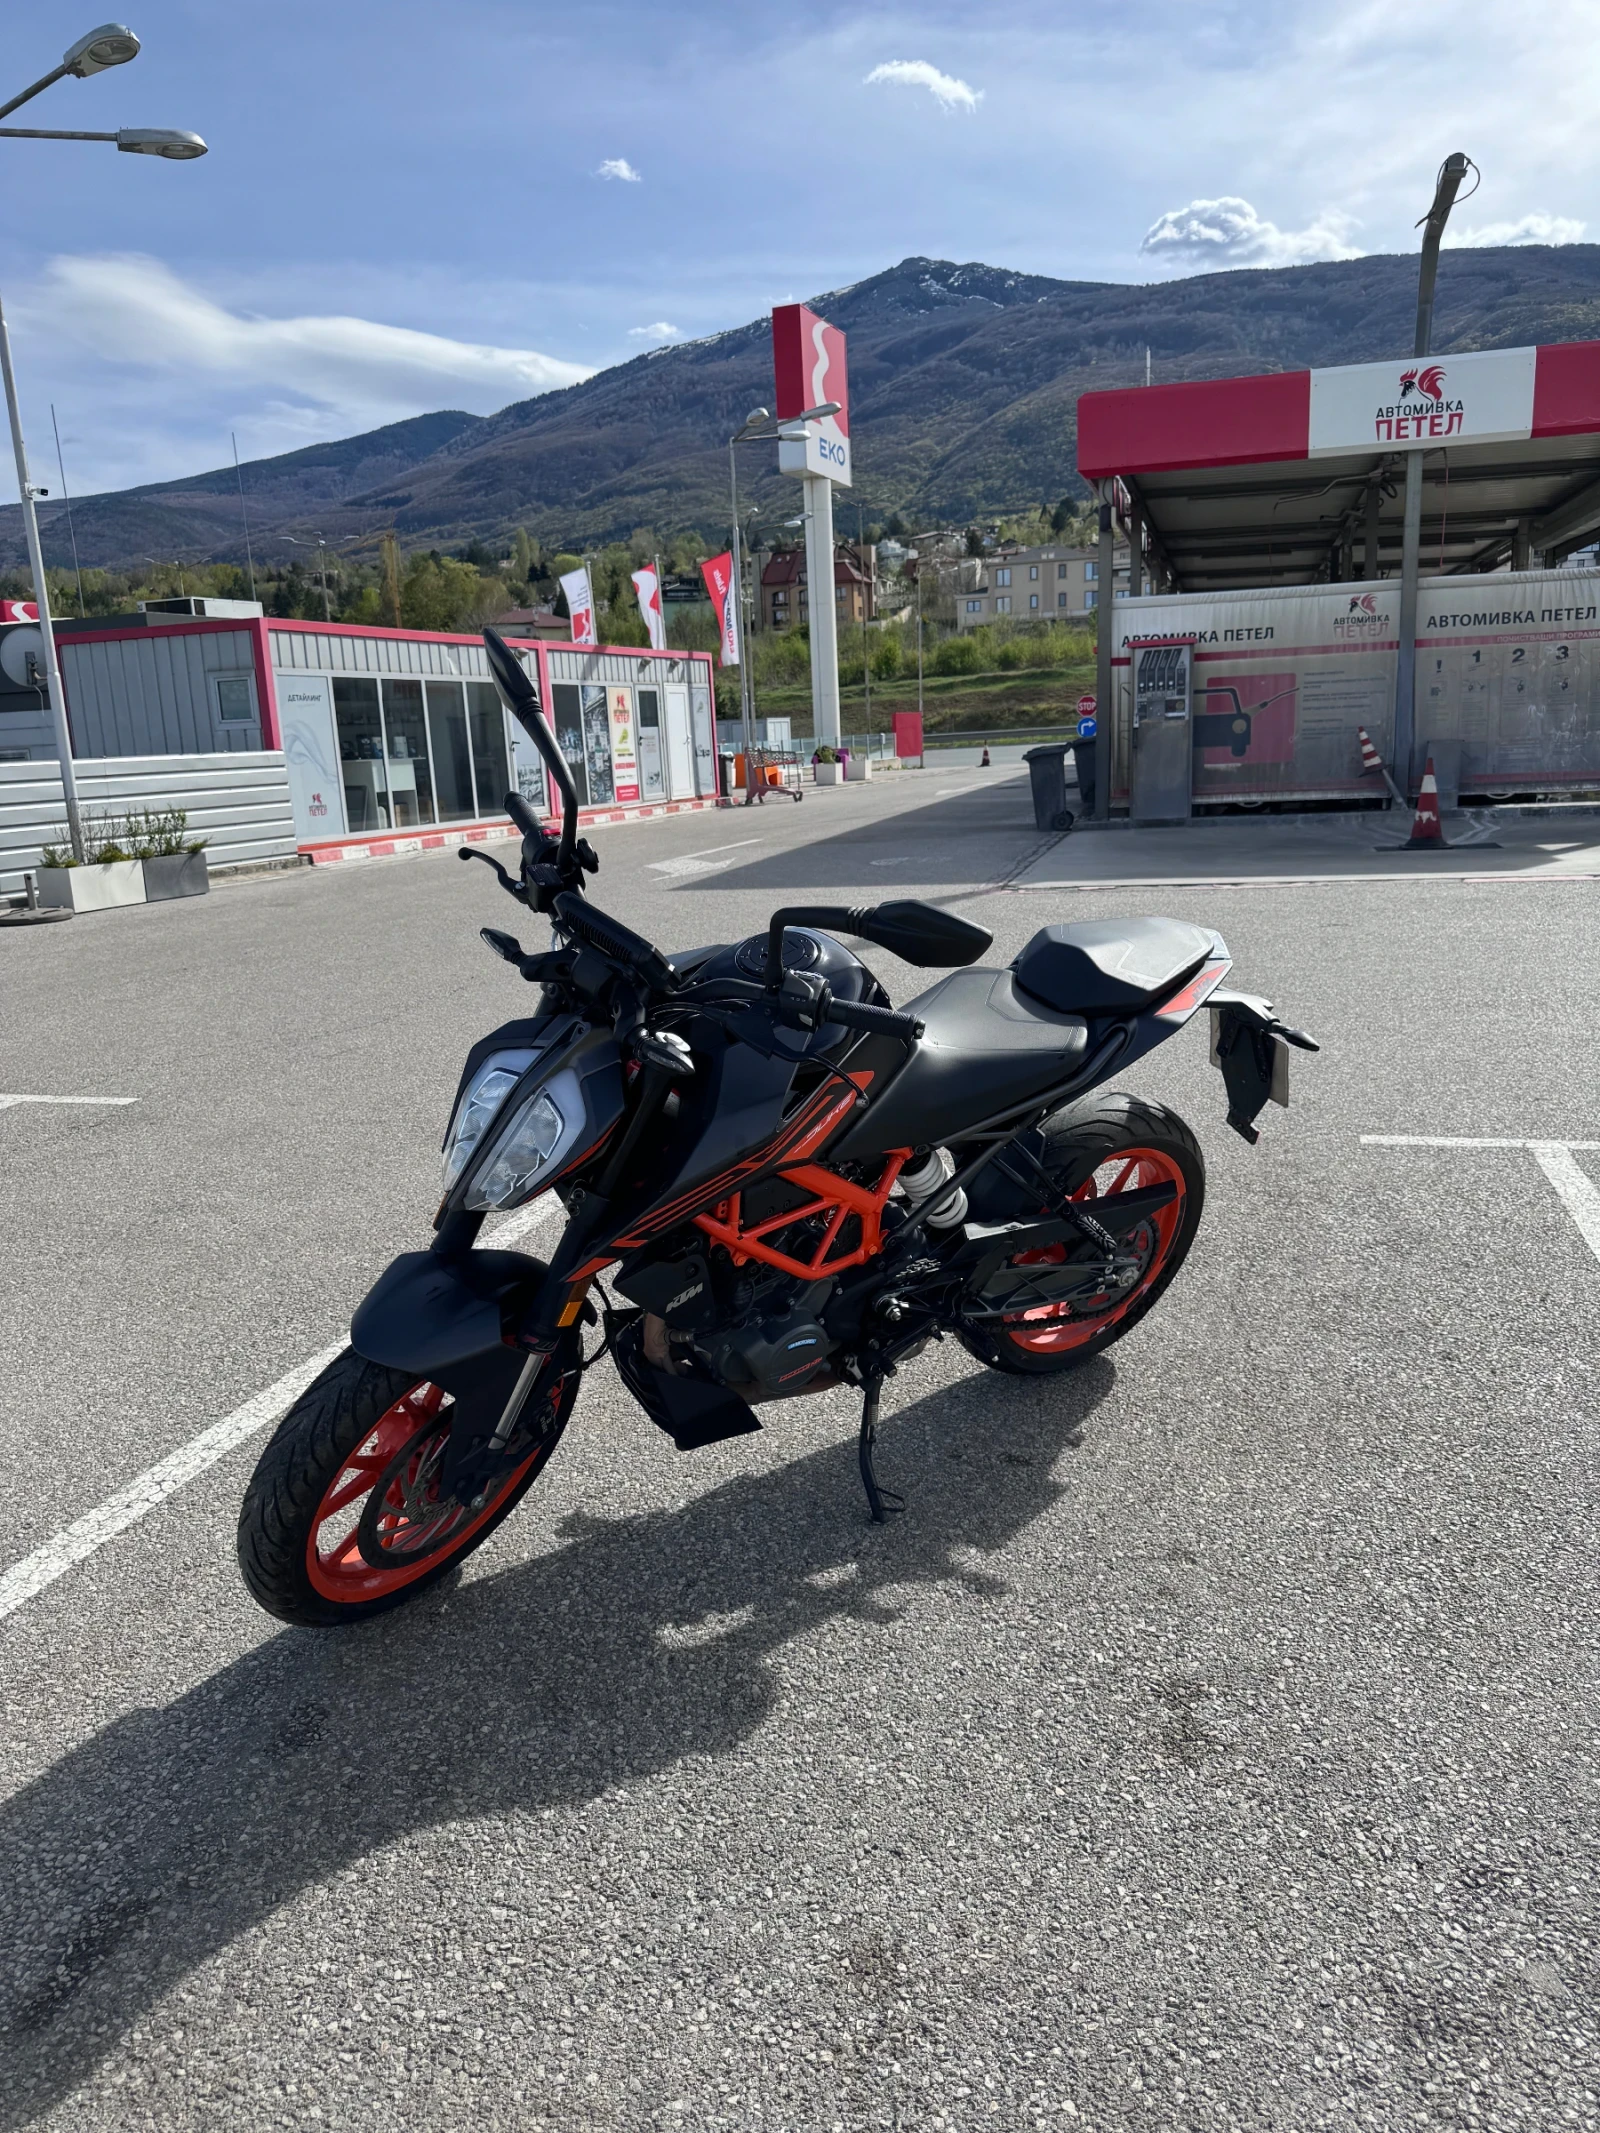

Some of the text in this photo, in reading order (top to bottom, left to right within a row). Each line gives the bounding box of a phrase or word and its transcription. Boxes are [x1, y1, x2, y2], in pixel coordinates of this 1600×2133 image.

[1375, 400, 1464, 418] АВТОМИВКА
[1375, 412, 1464, 441] ПЕТЕЛ
[819, 436, 846, 466] EKO
[1333, 614, 1390, 625] АВТОМИВКА
[1427, 607, 1597, 628] АВТОМИВКА ПЕТЕЛ
[1224, 627, 1274, 642] ПЕТЕЛ
[1333, 622, 1390, 639] ПЕТЕЛ
[1472, 650, 1481, 663] 1
[1512, 648, 1525, 663] 2
[1556, 645, 1569, 660] 3
[288, 693, 322, 702] ДЕТАЙЛИНГ
[1079, 702, 1097, 711] STOP
[665, 1282, 704, 1313] KTM
